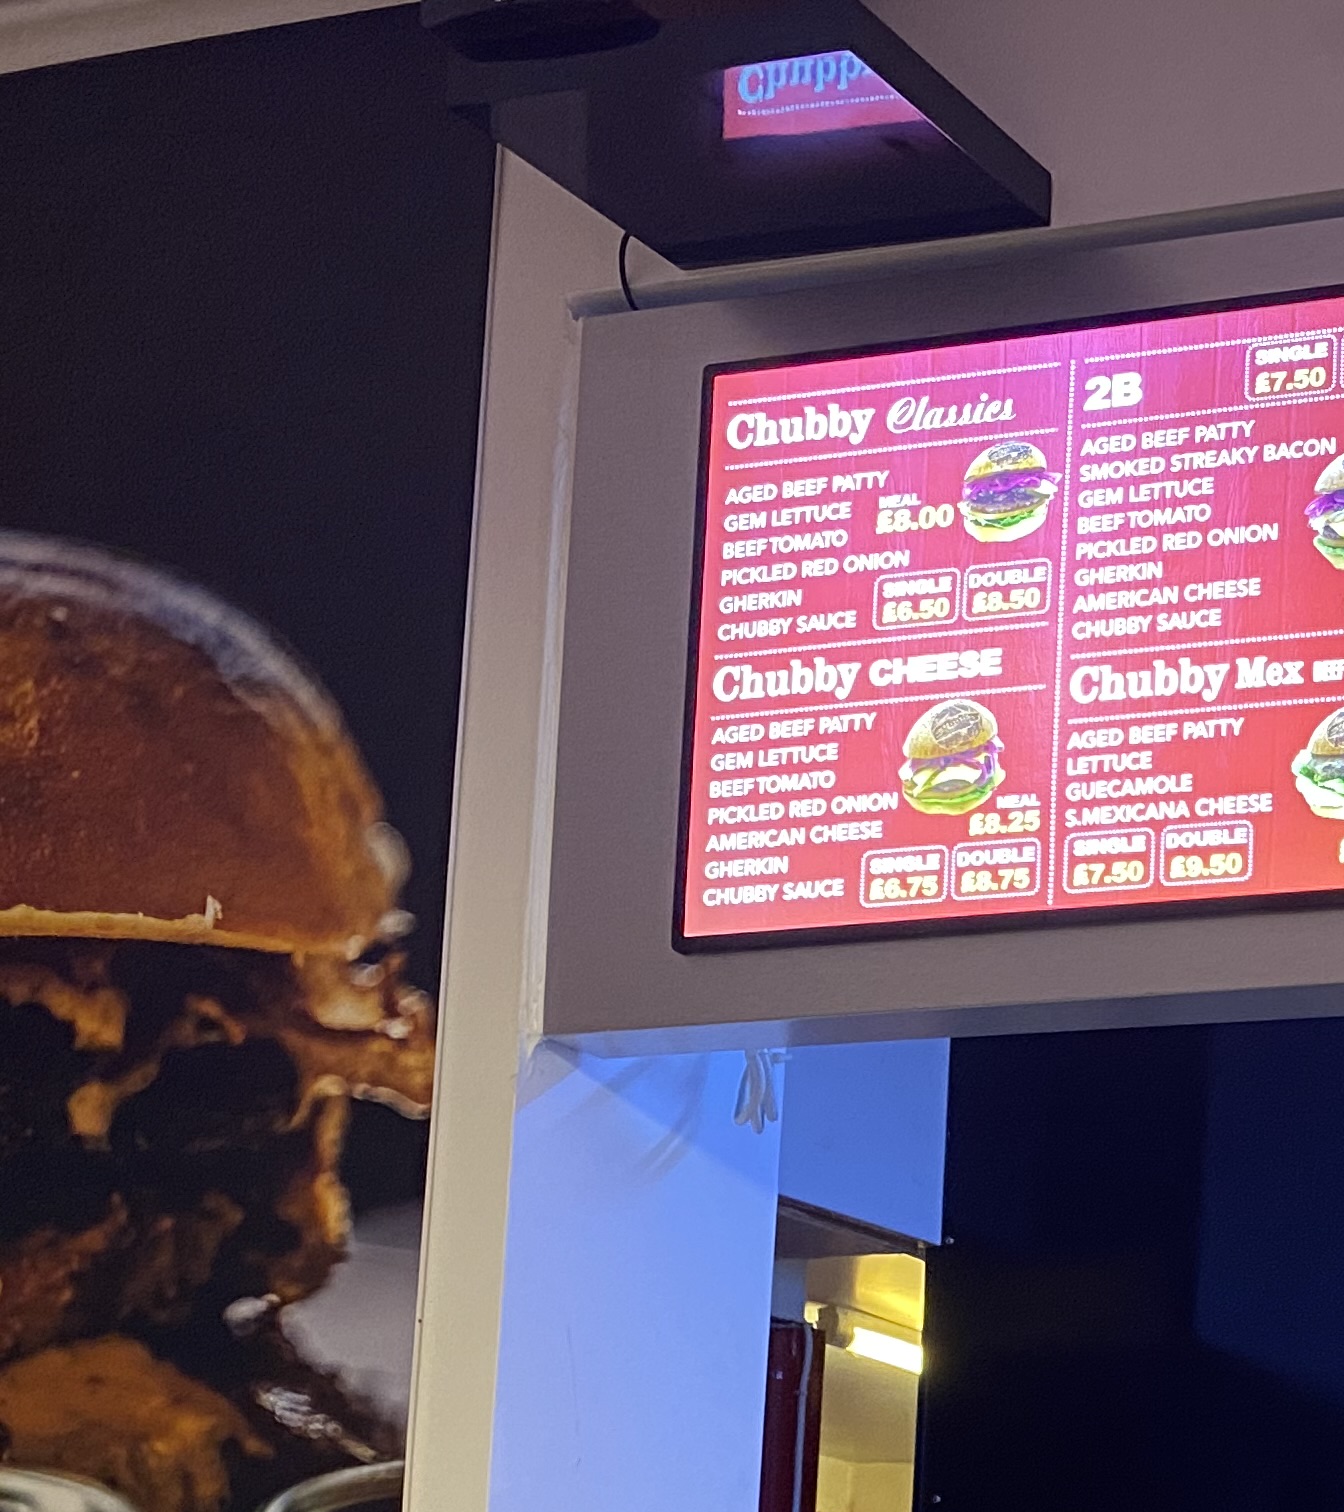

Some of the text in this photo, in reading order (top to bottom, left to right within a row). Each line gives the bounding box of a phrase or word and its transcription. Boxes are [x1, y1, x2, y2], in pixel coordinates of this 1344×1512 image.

[1083, 372, 1143, 411] 2B
[1255, 366, 1326, 394] £7.50
[726, 393, 1016, 450] Chubby Classics
[1080, 437, 1336, 482] SMOKED STREAKY BACON
[725, 470, 890, 505] AGED BEEF PATTY
[875, 503, 954, 534] £8.00
[882, 597, 950, 624] £6.50
[972, 587, 1040, 614] £8.50
[712, 648, 1002, 702] Chubby CHEESE
[1069, 656, 1305, 704] Chubby Mex
[1065, 773, 1193, 801] GUECAMOLE
[705, 820, 883, 852] AMERICAN CHEESE
[969, 810, 1040, 836] £8.25
